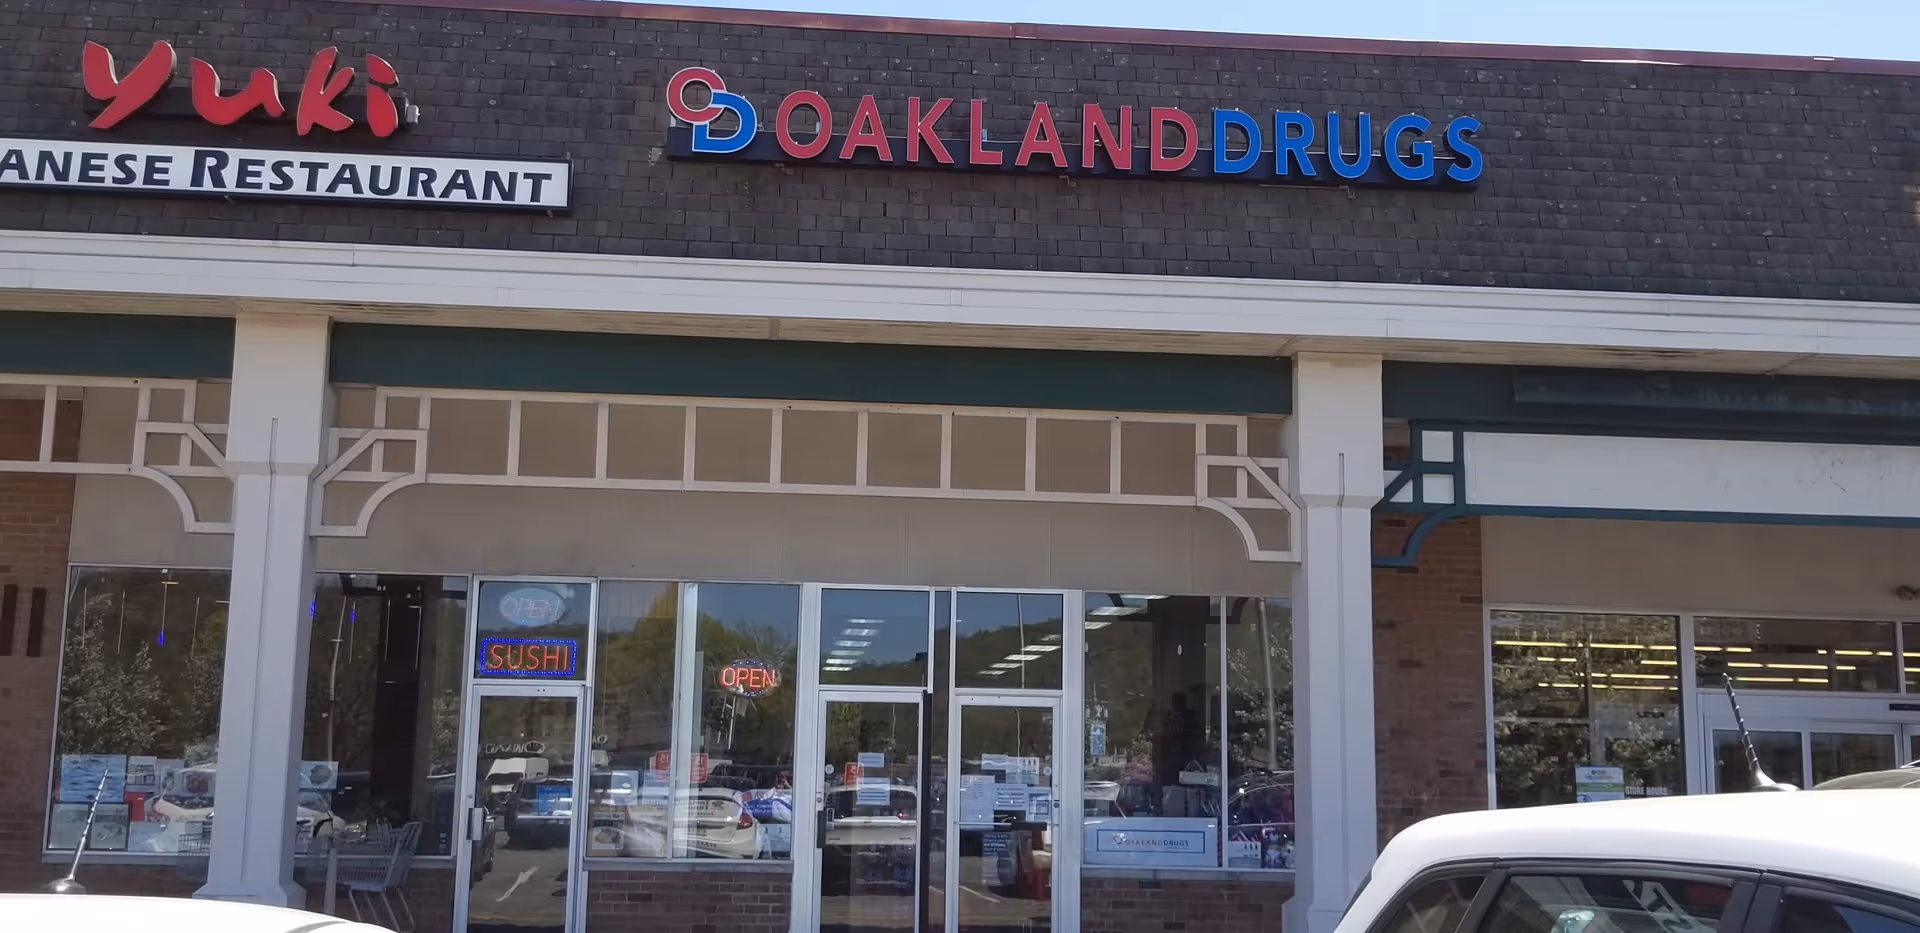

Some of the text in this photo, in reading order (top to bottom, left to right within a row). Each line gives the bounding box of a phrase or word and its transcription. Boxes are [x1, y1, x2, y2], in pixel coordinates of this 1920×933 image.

[190, 149, 553, 203] RESTAURANT
[500, 594, 560, 621] OPEN
[489, 643, 568, 671] SUSHI
[722, 666, 776, 688] OPEN
[1625, 786, 1645, 796] STORE
